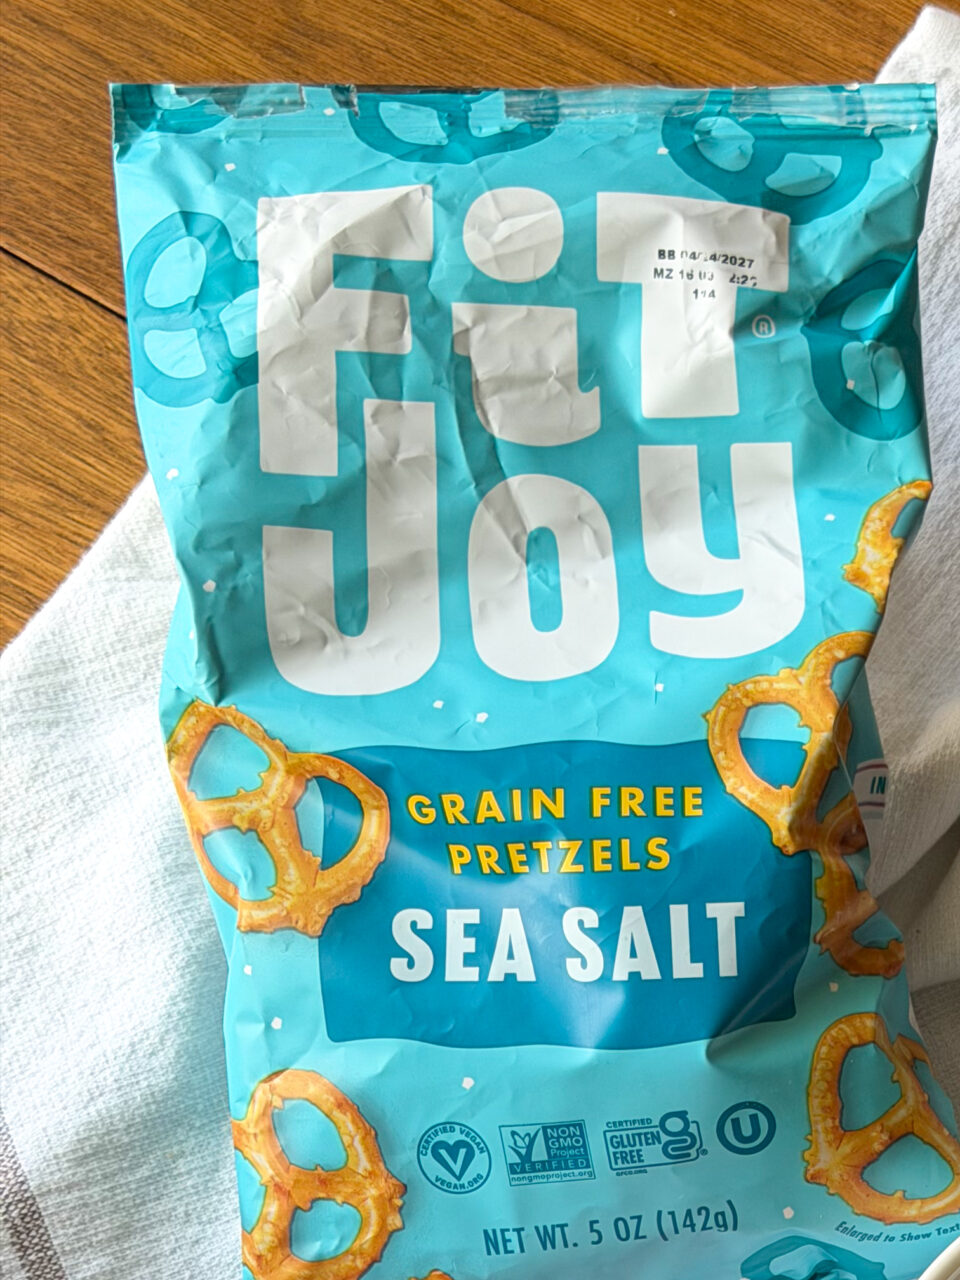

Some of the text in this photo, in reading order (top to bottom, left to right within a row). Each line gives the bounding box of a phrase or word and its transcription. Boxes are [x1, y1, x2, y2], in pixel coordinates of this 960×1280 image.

[658, 249, 676, 260] BB
[653, 267, 674, 280] MZ
[406, 786, 704, 825] GRAIN FREE
[448, 836, 671, 875] PRETZELS
[389, 901, 746, 983] SEA SALT
[547, 1126, 581, 1138] NON
[606, 1118, 653, 1129] CERTIFIED
[420, 1125, 487, 1157] CERTIFIED VEGAN
[549, 1136, 583, 1149] GMO
[610, 1131, 662, 1150] GLUTEN
[550, 1147, 585, 1159] Project
[612, 1149, 645, 1166] FREE
[513, 1159, 587, 1173] VERIFIED
[435, 1173, 484, 1191] VEGAN.ORG
[511, 1170, 593, 1184] nongmoproject.org
[482, 1199, 739, 1256] NET WT. 5 OZ (142g)
[835, 1221, 883, 1242] Enlarged
[883, 1232, 896, 1242] to
[899, 1232, 932, 1242] Show
